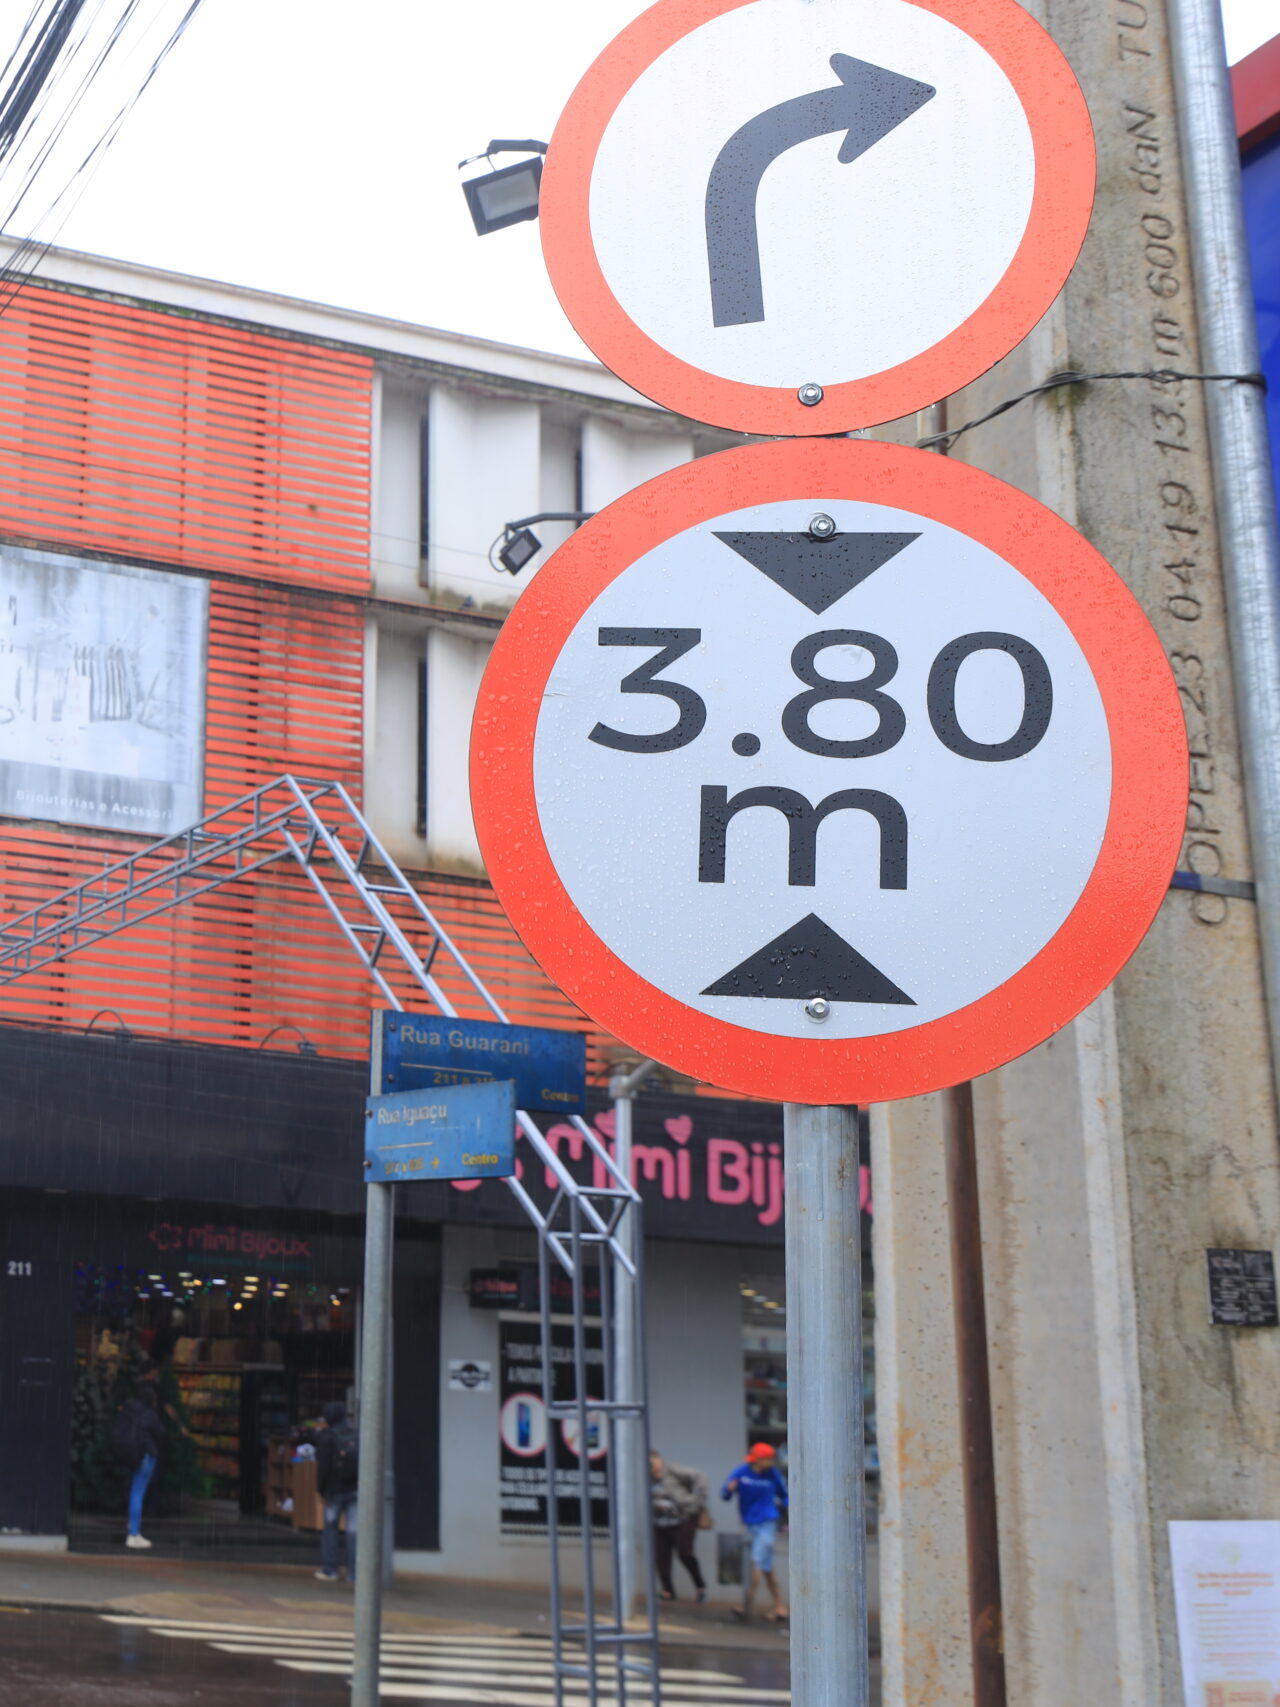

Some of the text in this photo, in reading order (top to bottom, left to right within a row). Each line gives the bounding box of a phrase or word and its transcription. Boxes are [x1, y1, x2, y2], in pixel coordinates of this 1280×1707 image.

[1139, 213, 1181, 299] 600
[586, 627, 1054, 762] 3.80
[698, 784, 909, 891] m
[400, 1025, 529, 1055] Rua Guarani
[378, 1104, 448, 1125] Rua Iguaçu
[461, 1152, 499, 1166] Centro
[239, 1231, 312, 1260] Bijoux
[7, 1260, 33, 1277] 211
